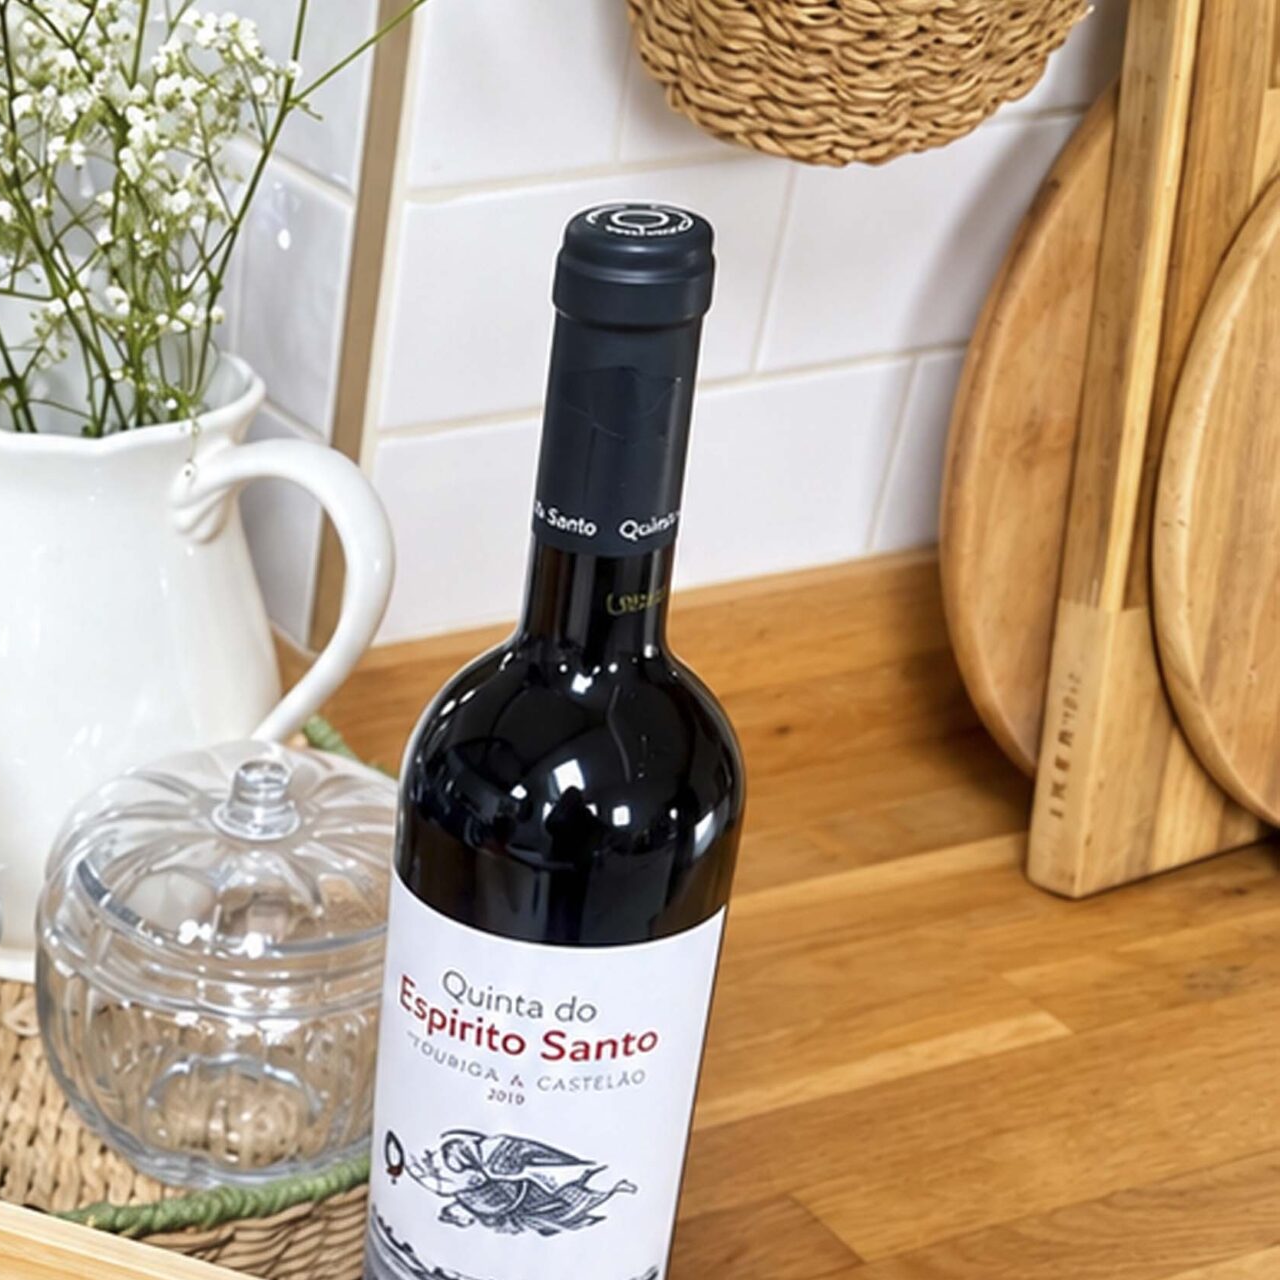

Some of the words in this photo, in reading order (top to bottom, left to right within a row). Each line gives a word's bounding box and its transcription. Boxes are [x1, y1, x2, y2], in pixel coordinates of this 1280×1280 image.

[547, 507, 597, 537] Santo
[399, 974, 527, 1056] Espirito
[540, 1030, 659, 1062] Santo
[442, 970, 544, 1020] Quinta
[554, 996, 598, 1023] do
